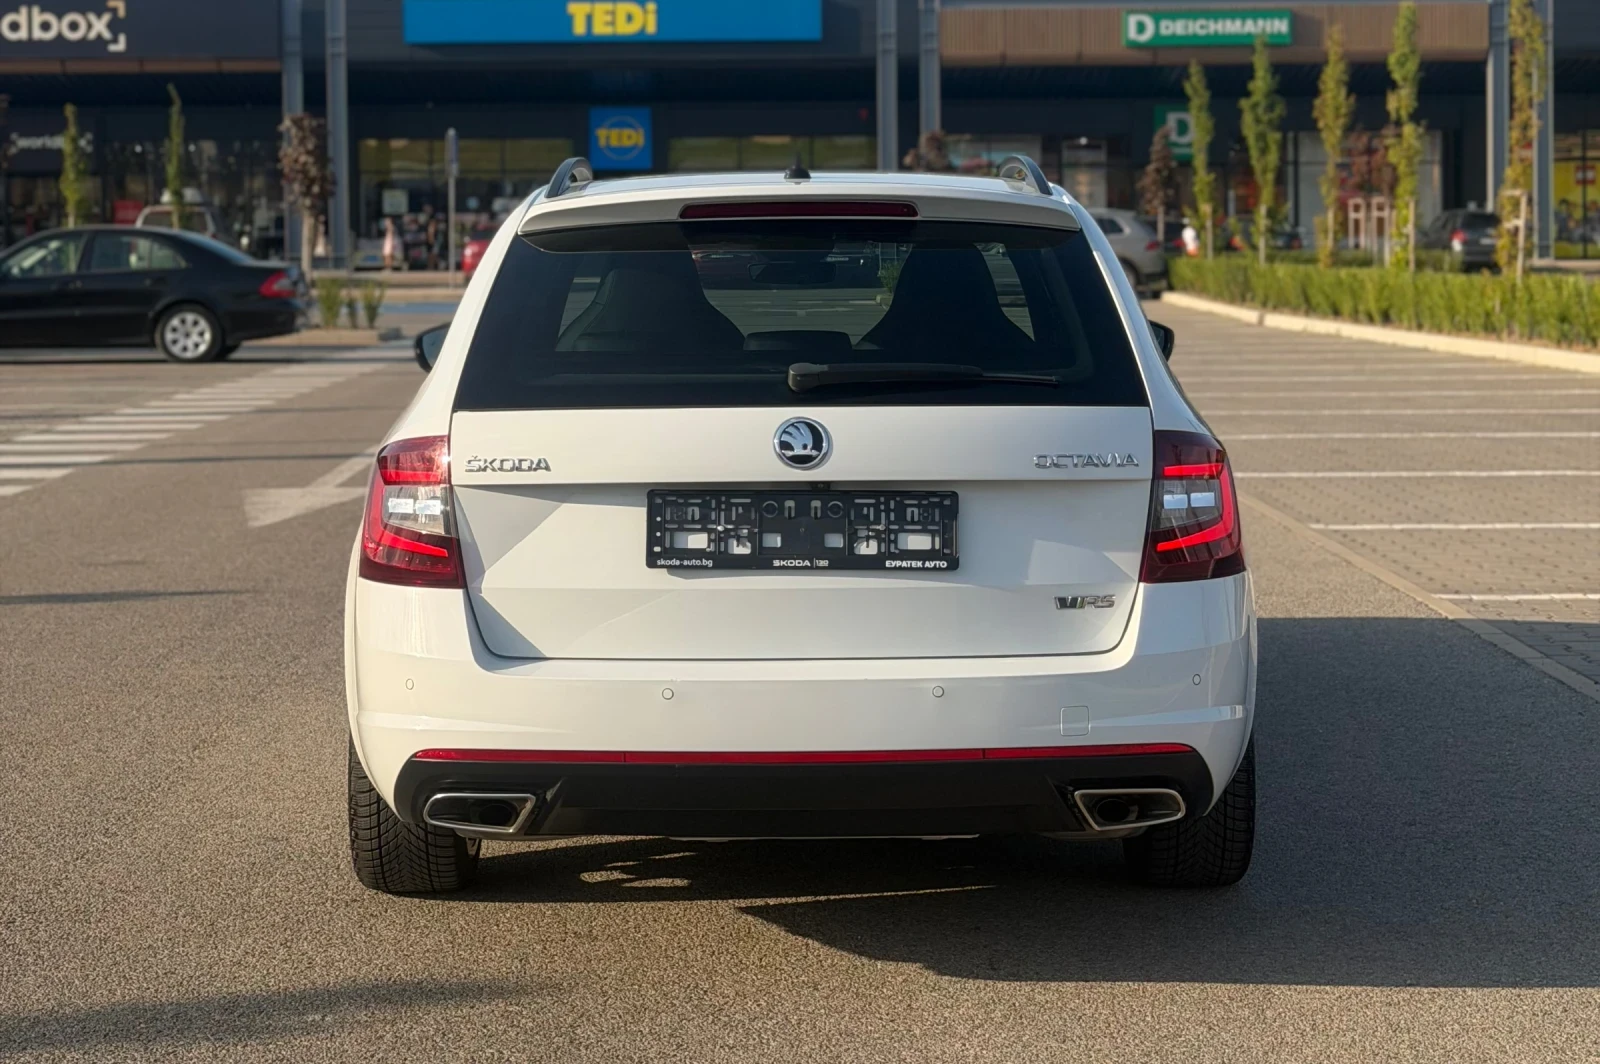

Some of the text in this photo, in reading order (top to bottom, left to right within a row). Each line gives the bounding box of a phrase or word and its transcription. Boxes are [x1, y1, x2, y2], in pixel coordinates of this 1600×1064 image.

[0, 5, 112, 41] dbox
[567, 2, 657, 36] TEDi
[1127, 14, 1289, 42] D DEICHMANN
[595, 128, 645, 147] TEDi
[464, 455, 551, 472] ŠKODA
[1034, 453, 1139, 469] OCTAVIA
[656, 558, 713, 567] skoda-auto.bg
[885, 560, 948, 568] ЕУРАТЕК АУТО
